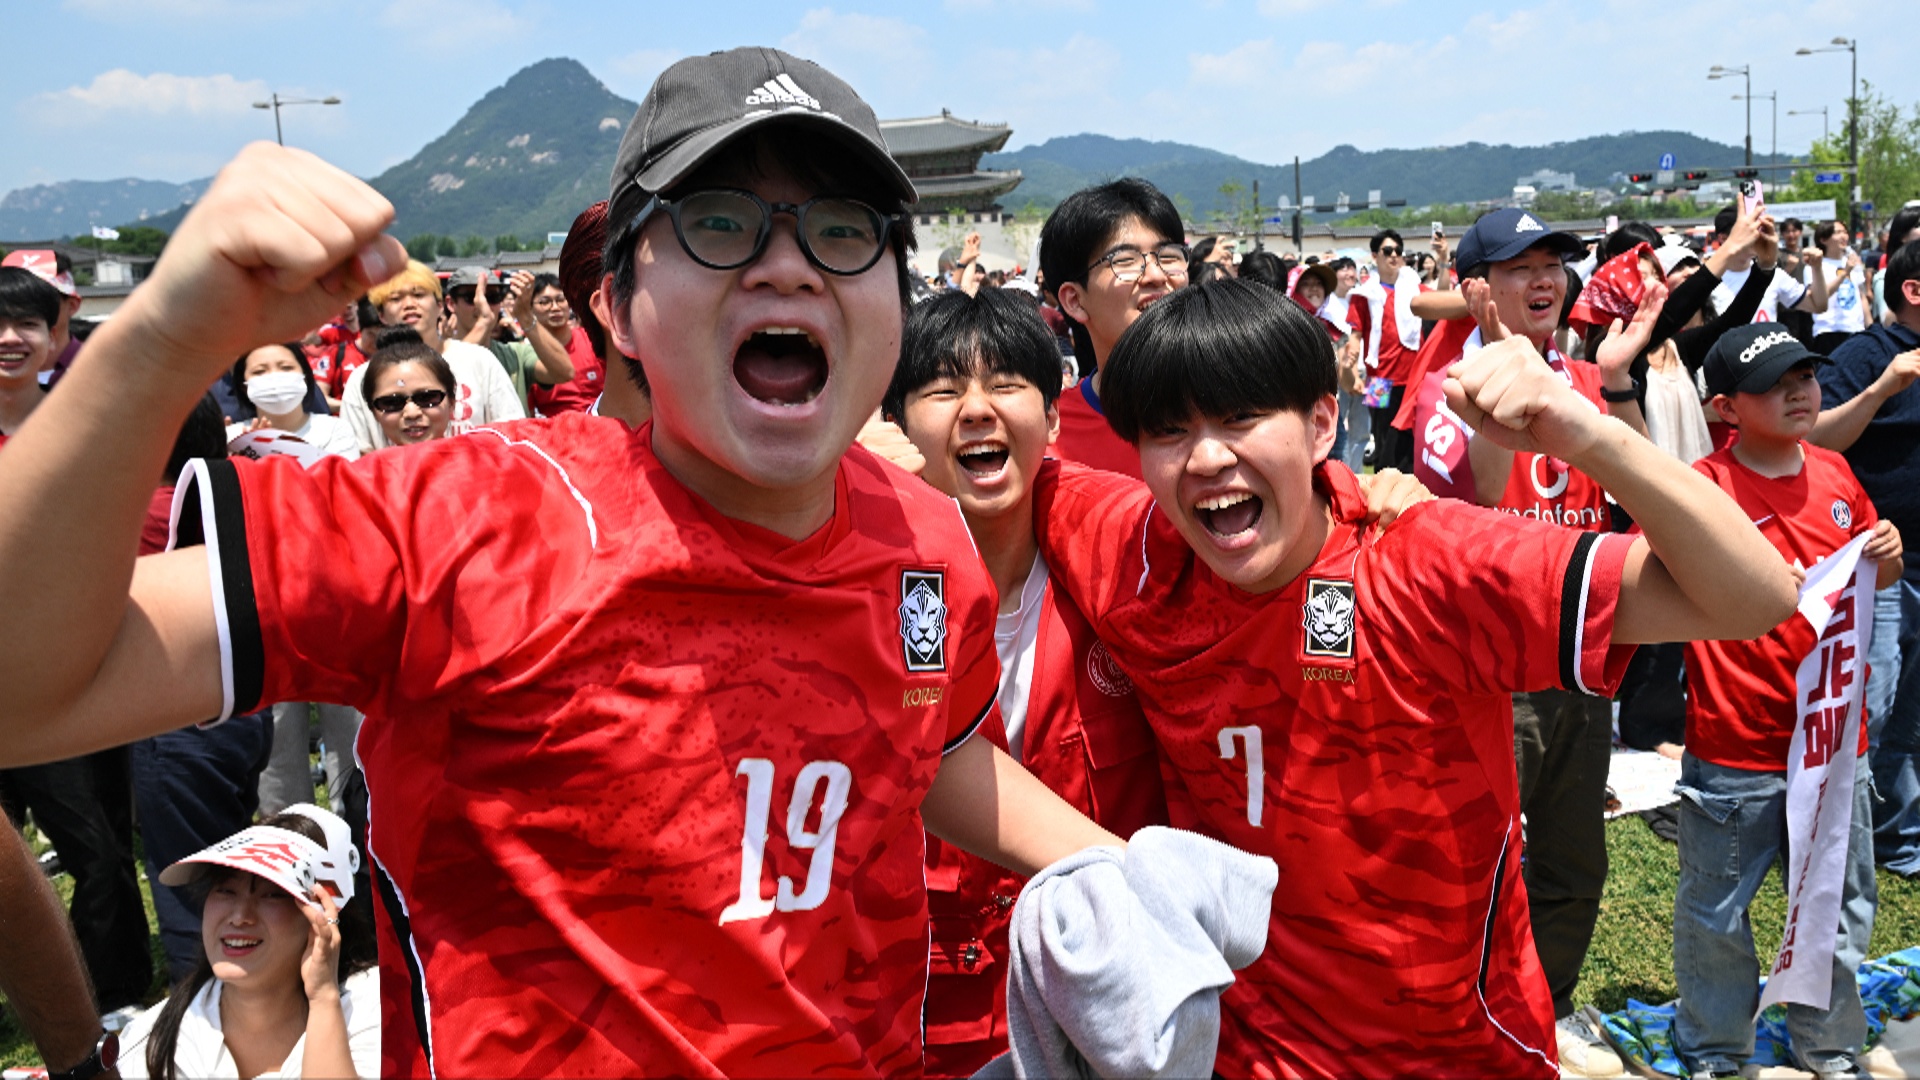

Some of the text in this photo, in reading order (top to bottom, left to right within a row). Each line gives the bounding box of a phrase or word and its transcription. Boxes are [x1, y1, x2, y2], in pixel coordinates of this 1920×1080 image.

[745, 94, 821, 111] adidas
[1302, 667, 1355, 685] KOREA
[903, 687, 944, 709] KOREA
[1217, 724, 1266, 829] 7
[718, 758, 852, 927] 19
